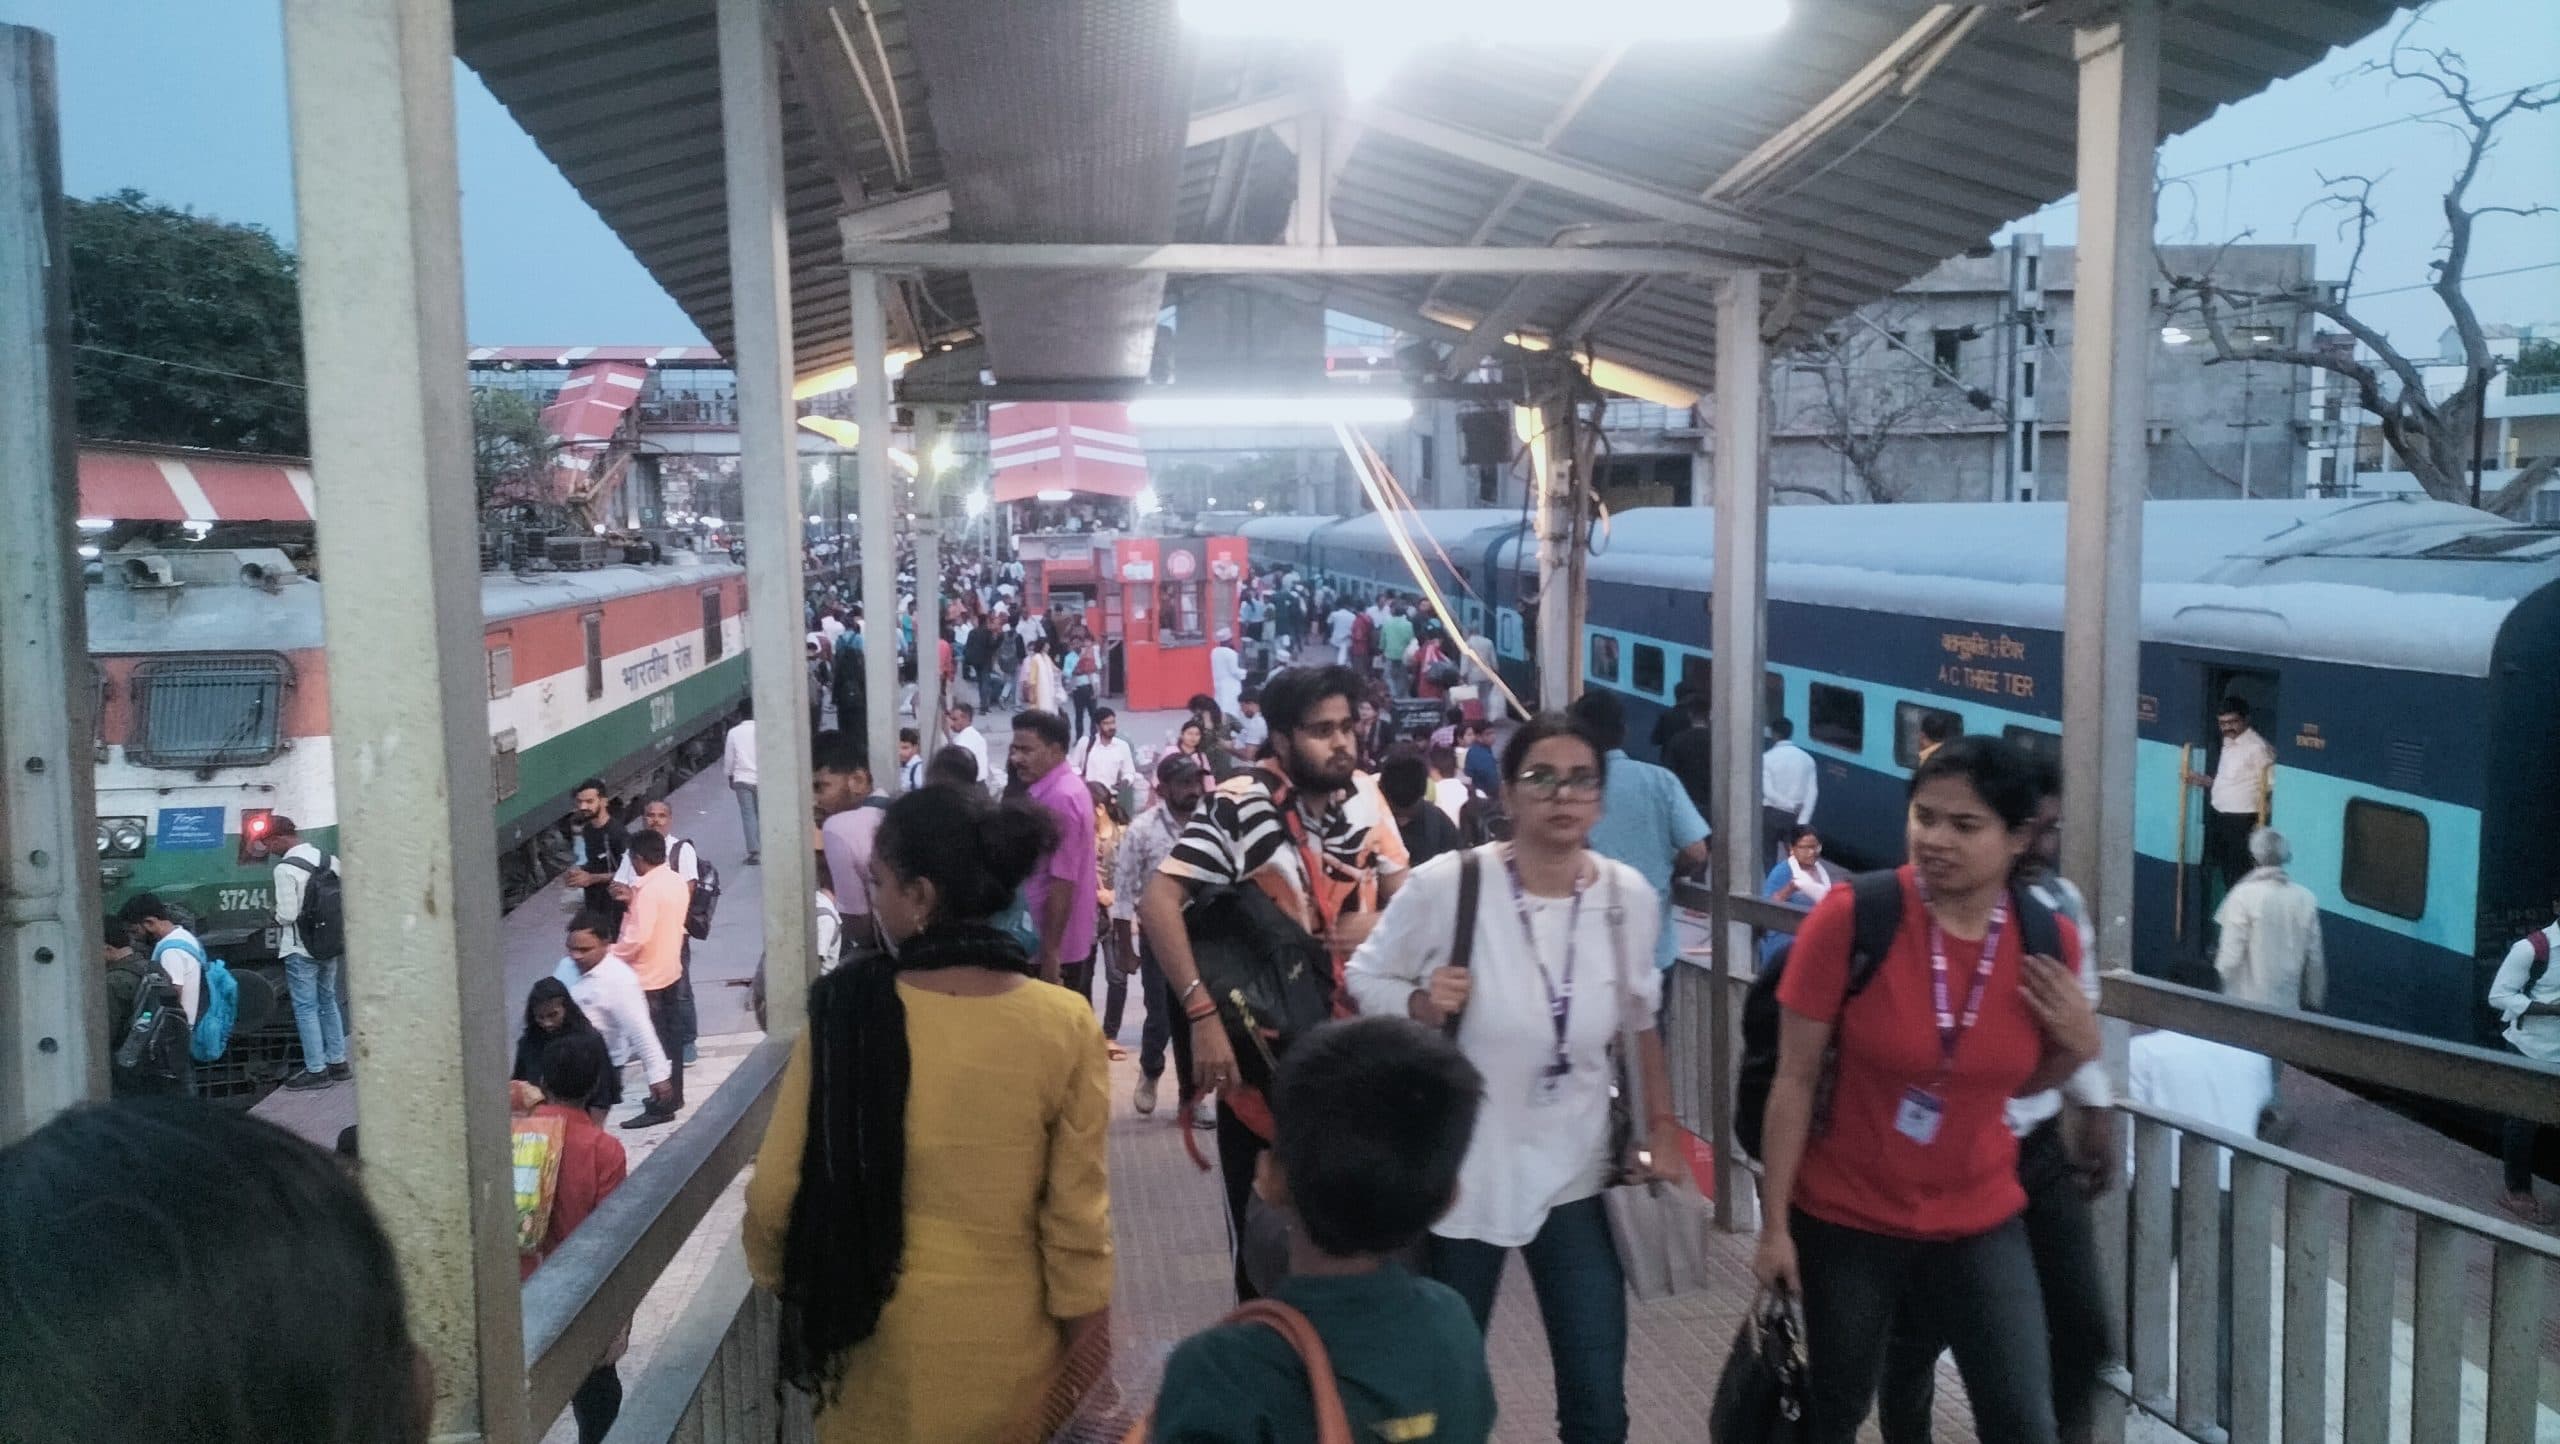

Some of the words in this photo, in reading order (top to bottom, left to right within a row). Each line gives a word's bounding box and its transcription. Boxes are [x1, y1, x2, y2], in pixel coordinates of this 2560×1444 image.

[621, 647, 670, 692] भारतीय
[673, 639, 693, 673] रेल
[1963, 666, 2000, 693] THREE
[2002, 671, 2034, 698] TIER
[219, 887, 271, 911] 37241
